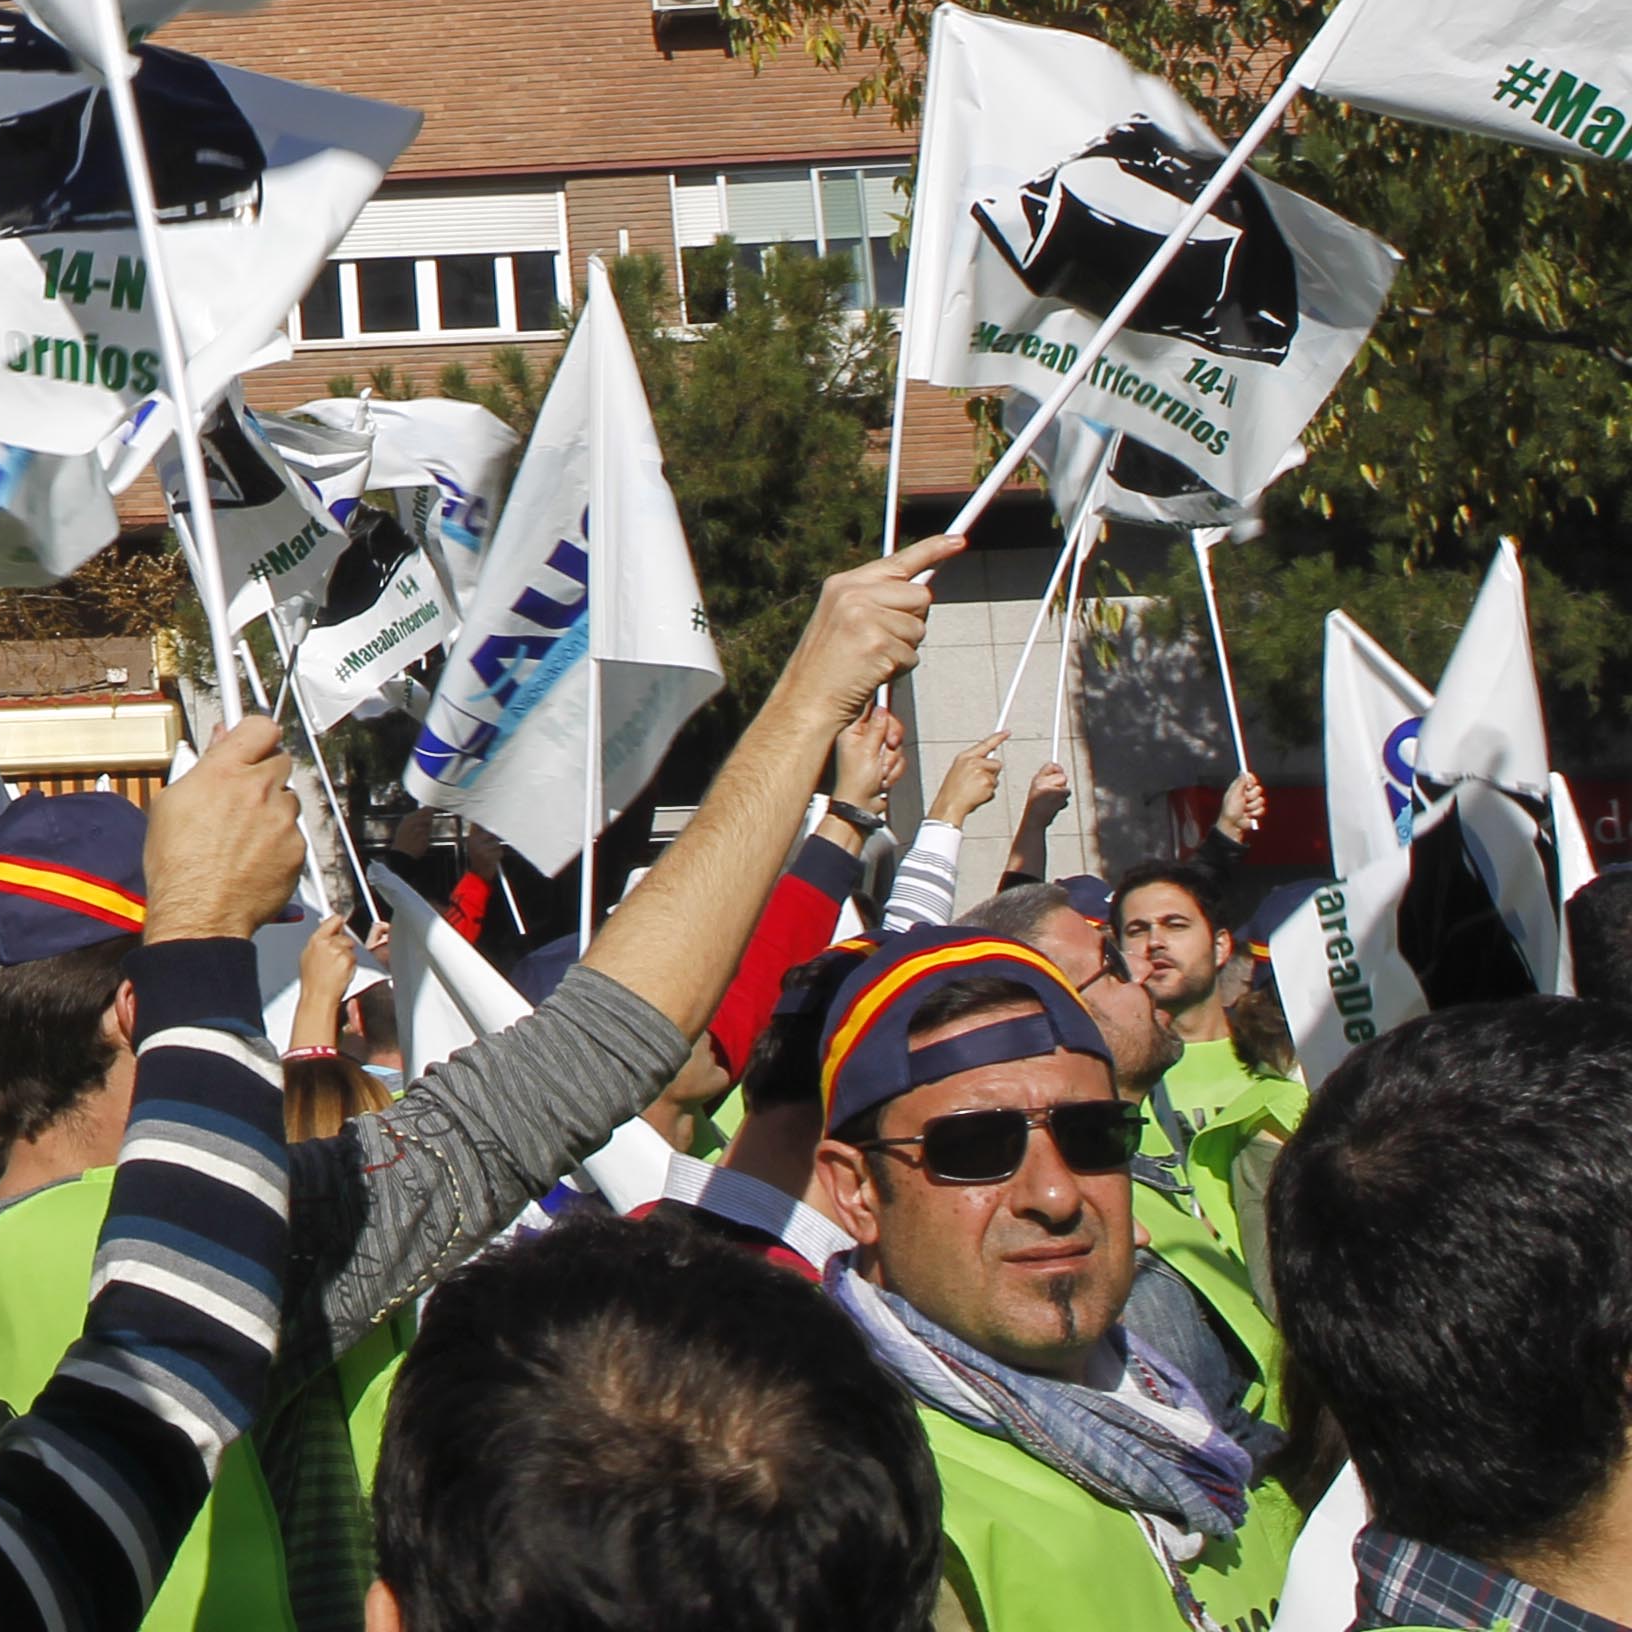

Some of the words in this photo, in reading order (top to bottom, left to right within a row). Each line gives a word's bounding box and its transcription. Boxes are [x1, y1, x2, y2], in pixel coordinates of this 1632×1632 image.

[39, 247, 147, 313] 14-N
[970, 321, 1232, 456] #MareaDTricornios
[333, 599, 440, 685] #MareaDeTricornios
[470, 508, 590, 709] AU
